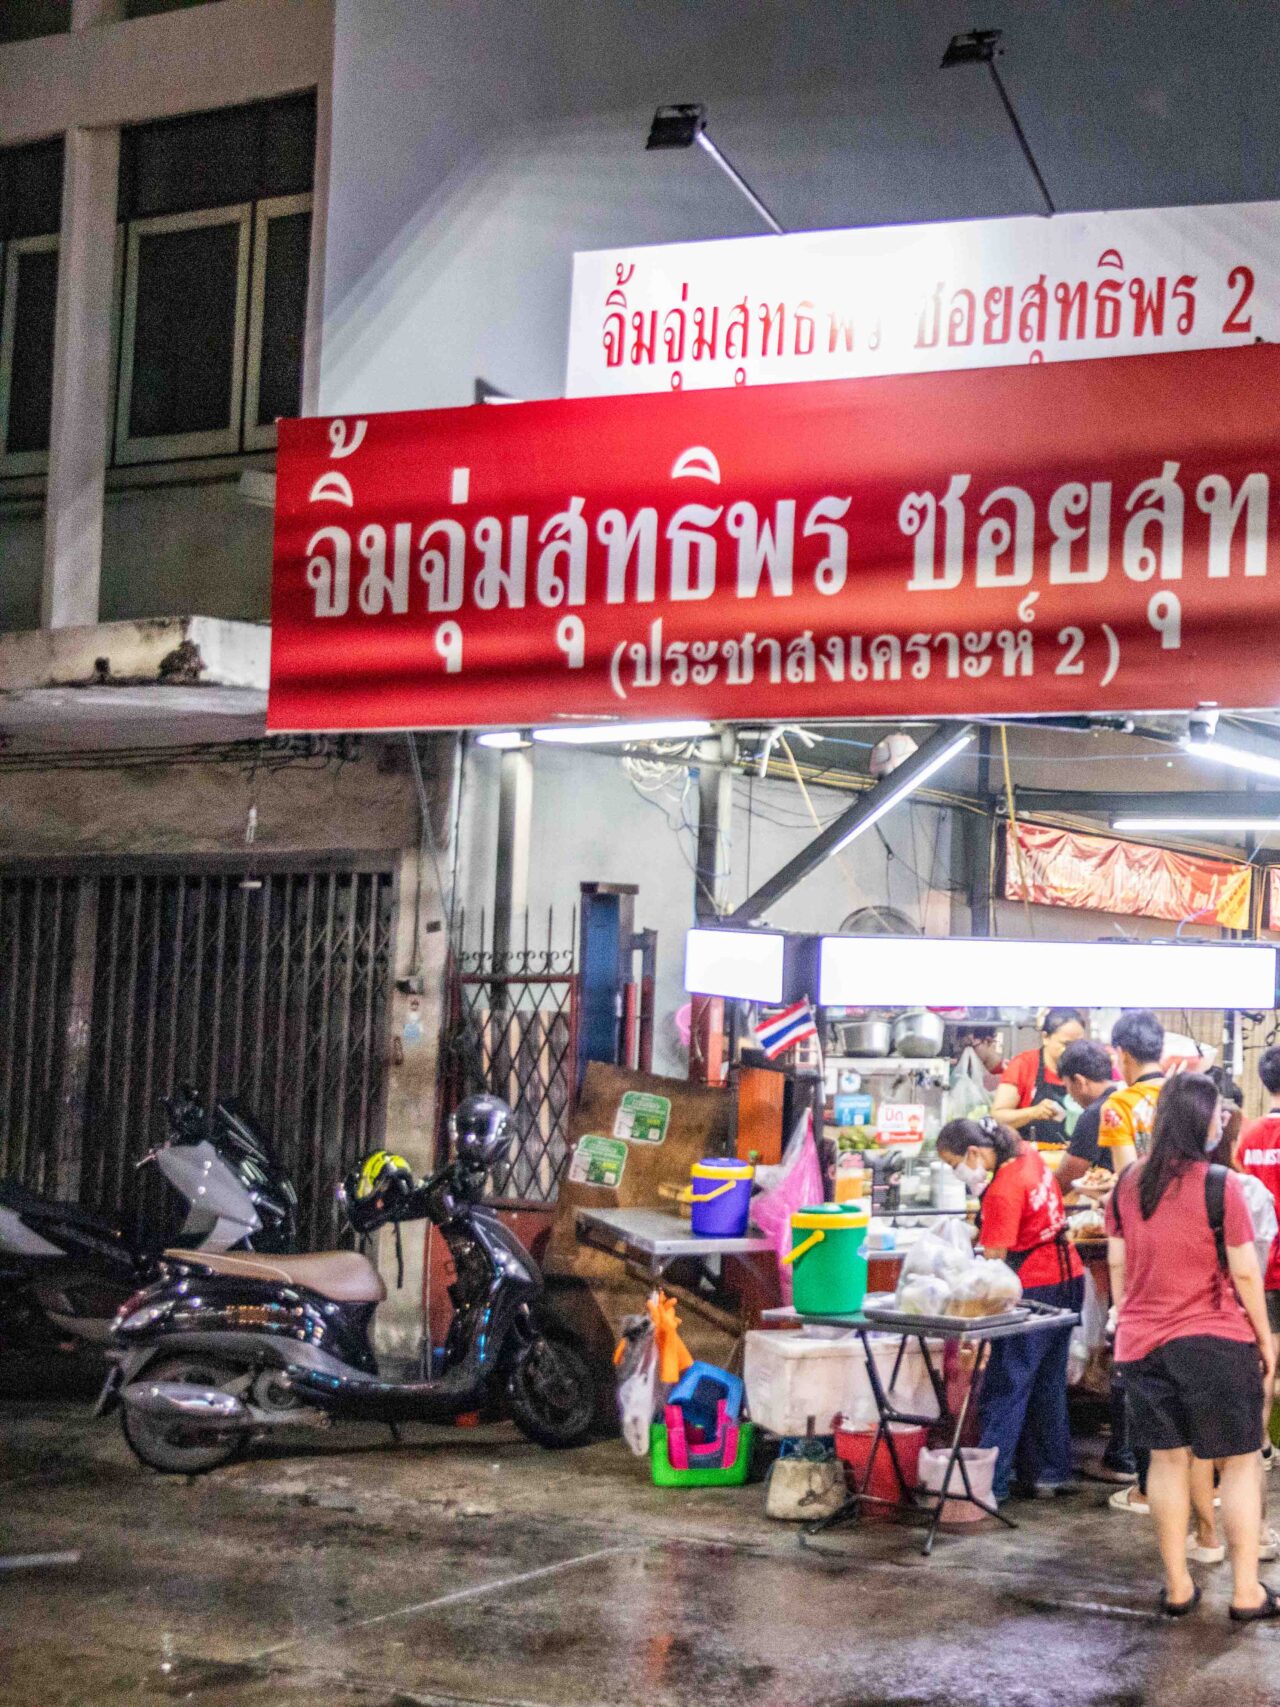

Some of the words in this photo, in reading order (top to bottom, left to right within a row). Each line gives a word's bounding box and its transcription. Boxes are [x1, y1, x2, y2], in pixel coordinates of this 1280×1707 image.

[602, 262, 883, 392] จิ้มจุ่มสุทธพ
[1222, 265, 1256, 333] 2
[305, 418, 853, 673] จิ้มจุ่มสุทธิพร
[610, 591, 1034, 699] (ประชาสงเคราะห์
